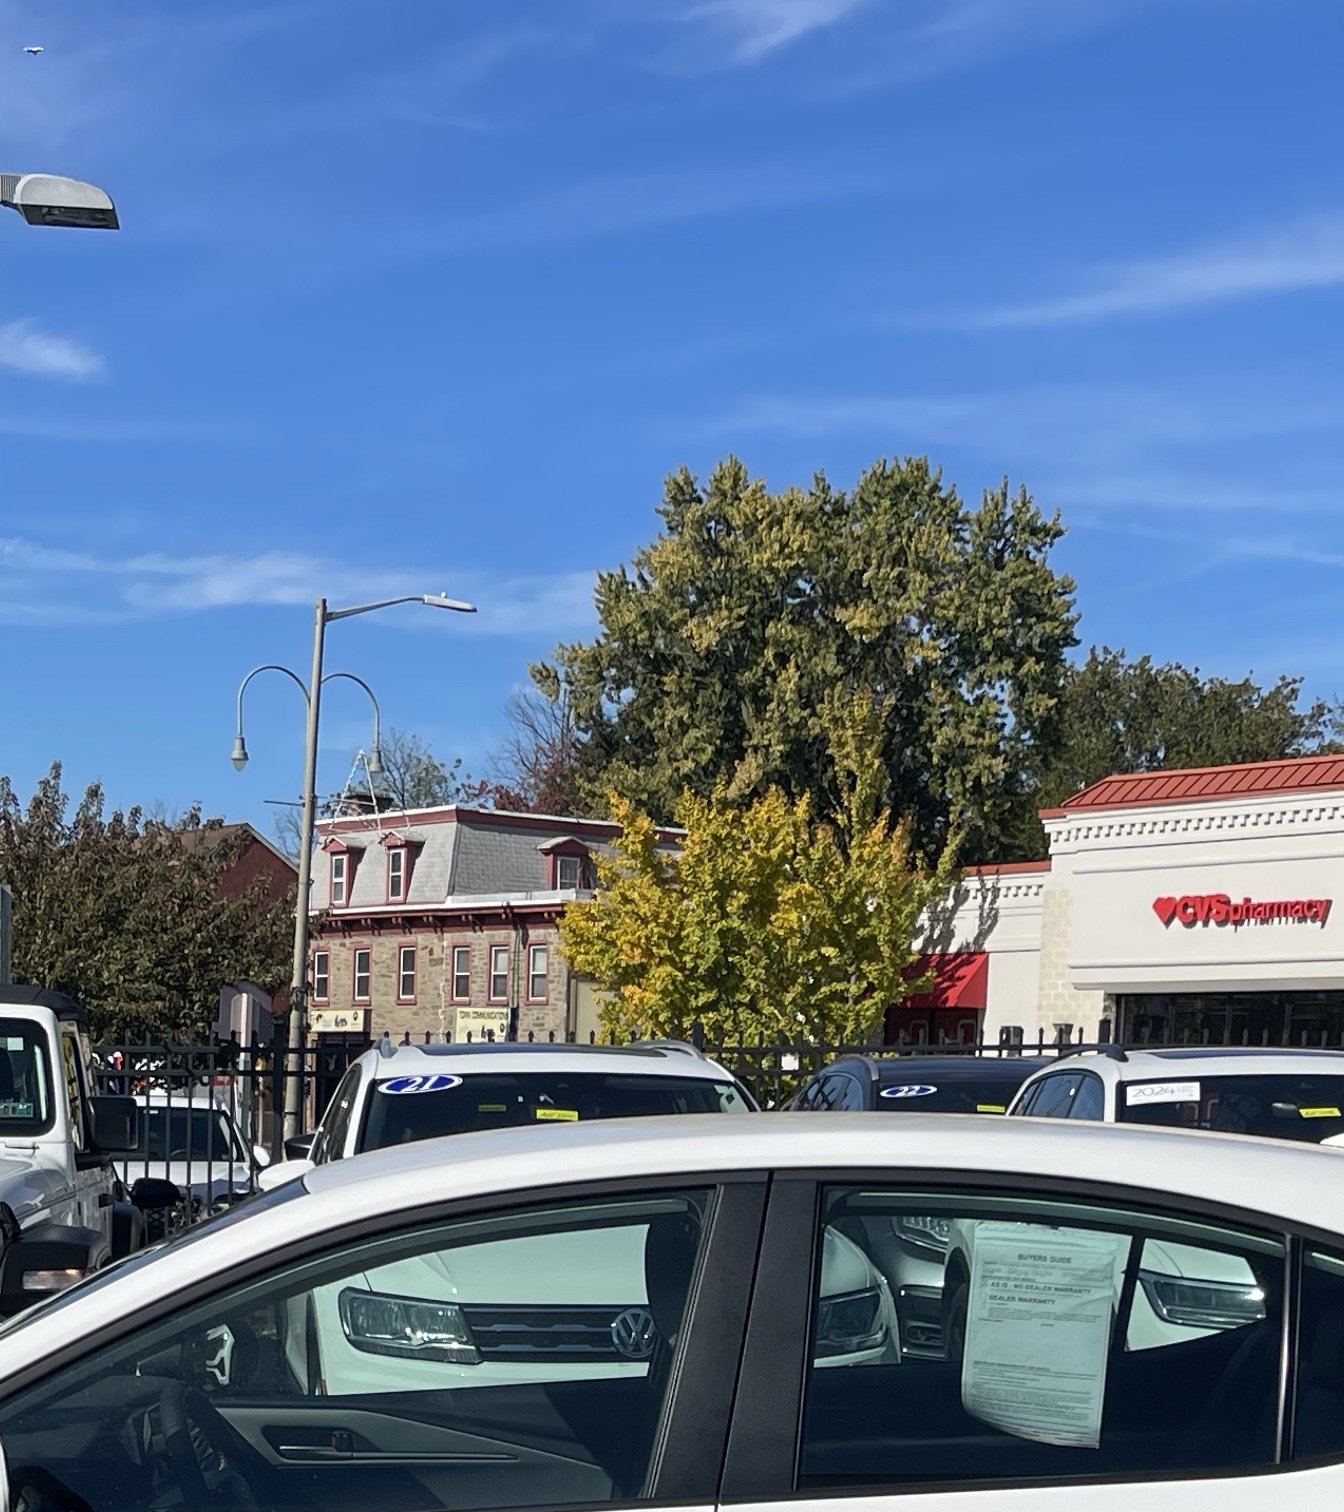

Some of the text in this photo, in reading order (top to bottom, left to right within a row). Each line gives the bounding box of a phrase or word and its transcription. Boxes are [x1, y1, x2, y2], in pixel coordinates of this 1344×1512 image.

[400, 1075, 440, 1092] 21
[893, 1085, 919, 1097] 22
[1132, 1086, 1174, 1098] 2024
[1018, 1254, 1072, 1264] BUYERS GUIDE
